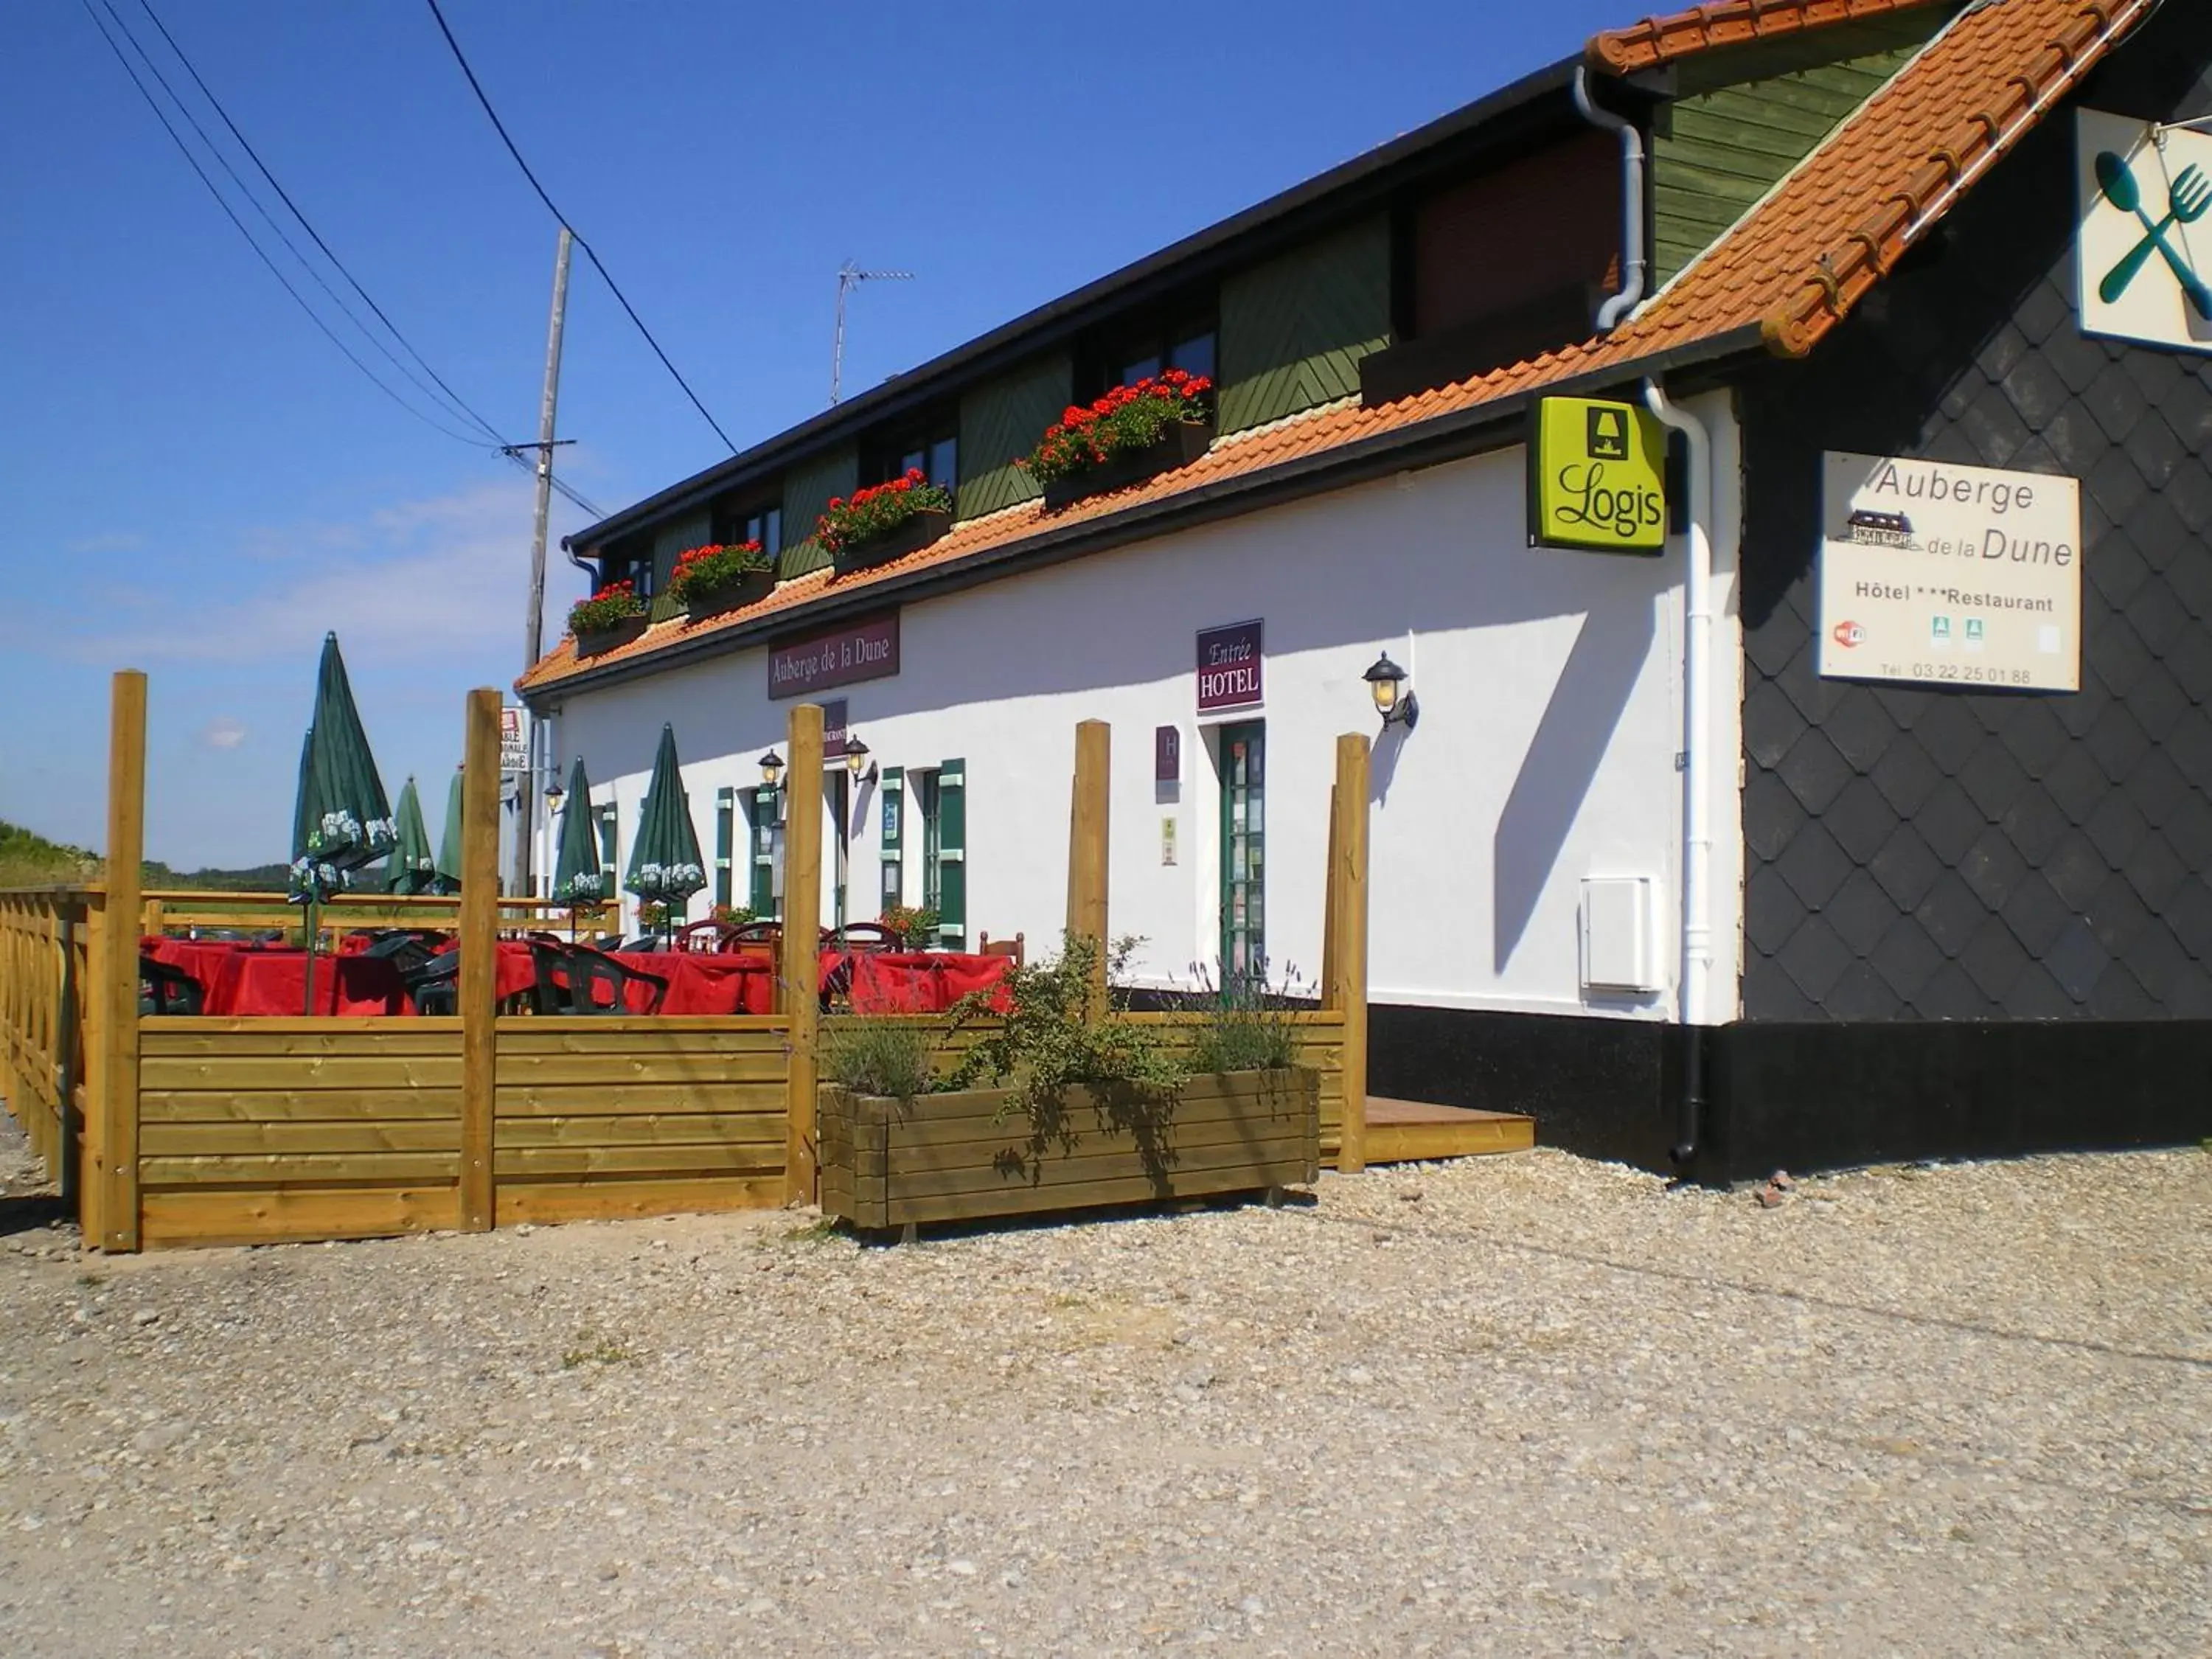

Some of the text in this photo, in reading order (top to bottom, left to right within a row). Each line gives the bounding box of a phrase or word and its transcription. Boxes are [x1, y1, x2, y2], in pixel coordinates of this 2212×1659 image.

[1555, 462, 1661, 538] Logis
[1876, 464, 2034, 514] Auberge
[1927, 529, 2073, 566] de la Dune
[1855, 581, 1910, 601] Hôtel
[773, 637, 889, 684] Auberge de la Dune
[1209, 636, 1251, 666] Entrée
[1200, 667, 1259, 698] HOTEL
[1913, 663, 1933, 678] 03
[1938, 665, 1958, 679] 22
[1964, 666, 1983, 681] 25
[1988, 668, 2005, 683] 01
